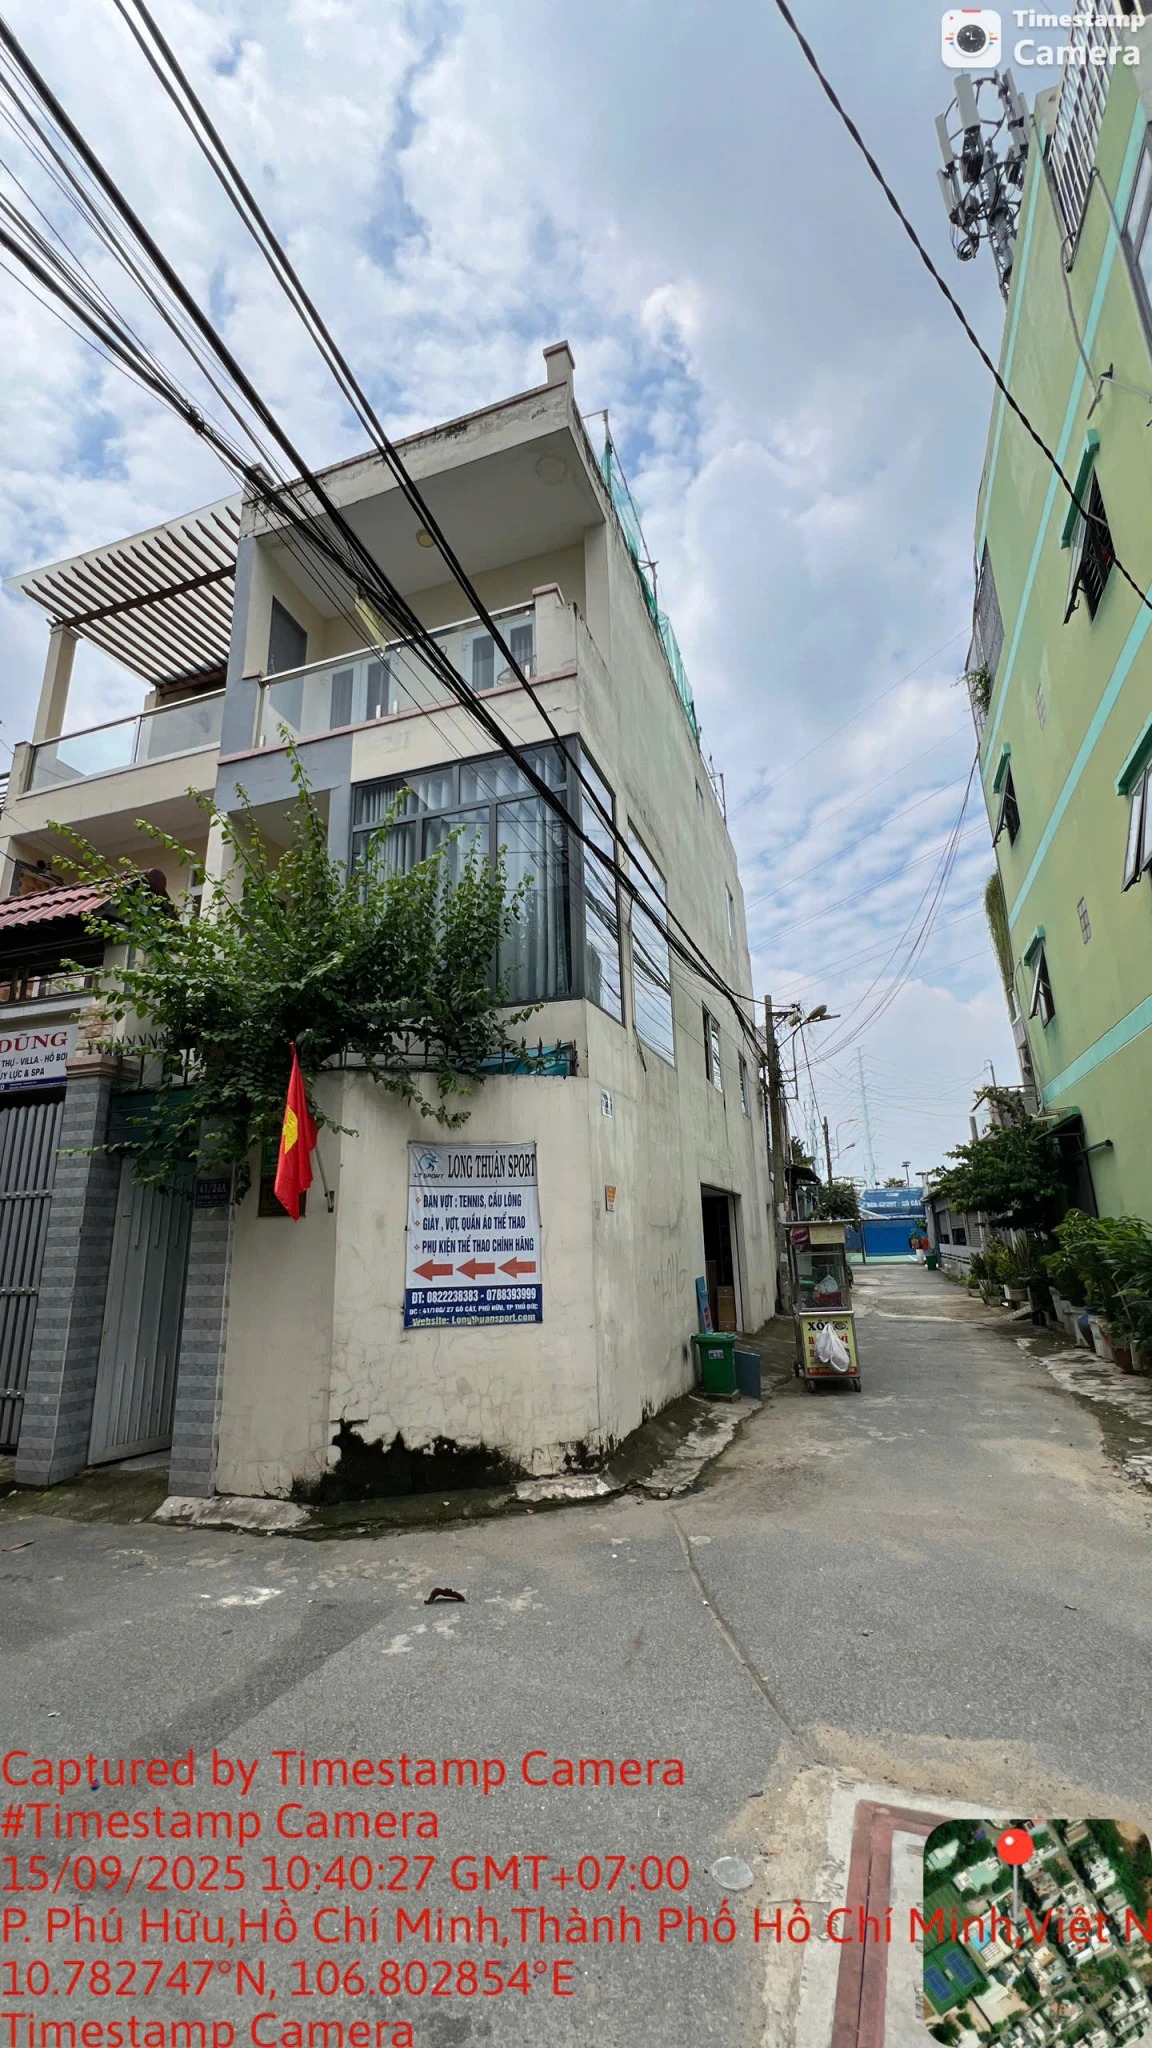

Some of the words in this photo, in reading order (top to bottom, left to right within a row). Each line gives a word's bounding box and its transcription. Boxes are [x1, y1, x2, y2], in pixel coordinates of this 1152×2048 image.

[20, 1056, 38, 1065] VILLA
[24, 1069, 29, 1077] &
[31, 1068, 45, 1076] SPA
[448, 1155, 473, 1178] LONG
[508, 1154, 536, 1178] SPORT
[459, 1194, 486, 1209] TENNIS,
[508, 1215, 526, 1229] THAO
[472, 1239, 490, 1253] THAO
[492, 1236, 513, 1251] CHÍNH
[426, 1290, 479, 1303] 0822238383
[486, 1288, 536, 1301] 0788393999
[412, 1317, 449, 1326] Website:
